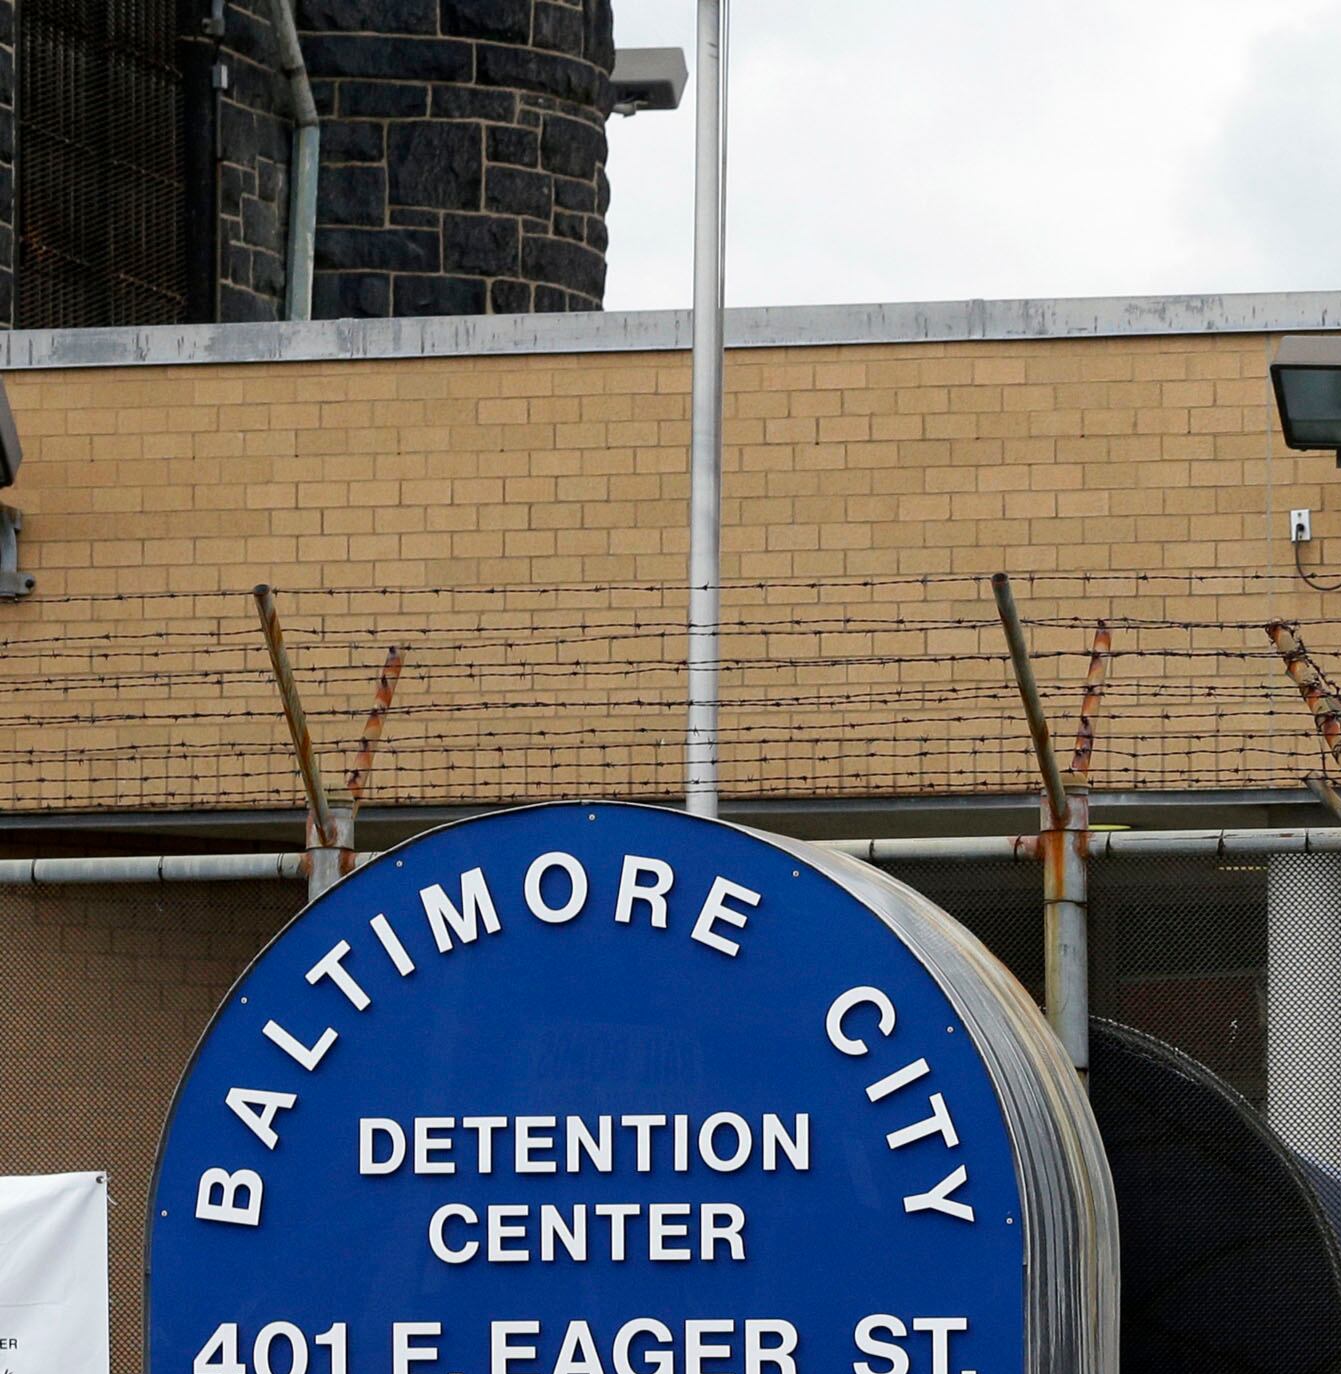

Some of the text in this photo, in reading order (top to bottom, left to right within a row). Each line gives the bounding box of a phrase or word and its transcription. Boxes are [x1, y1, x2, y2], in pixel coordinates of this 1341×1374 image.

[195, 851, 976, 1226] BALTIMORE CITY
[359, 1111, 809, 1175] DETENTION
[429, 1203, 746, 1264] CENTER
